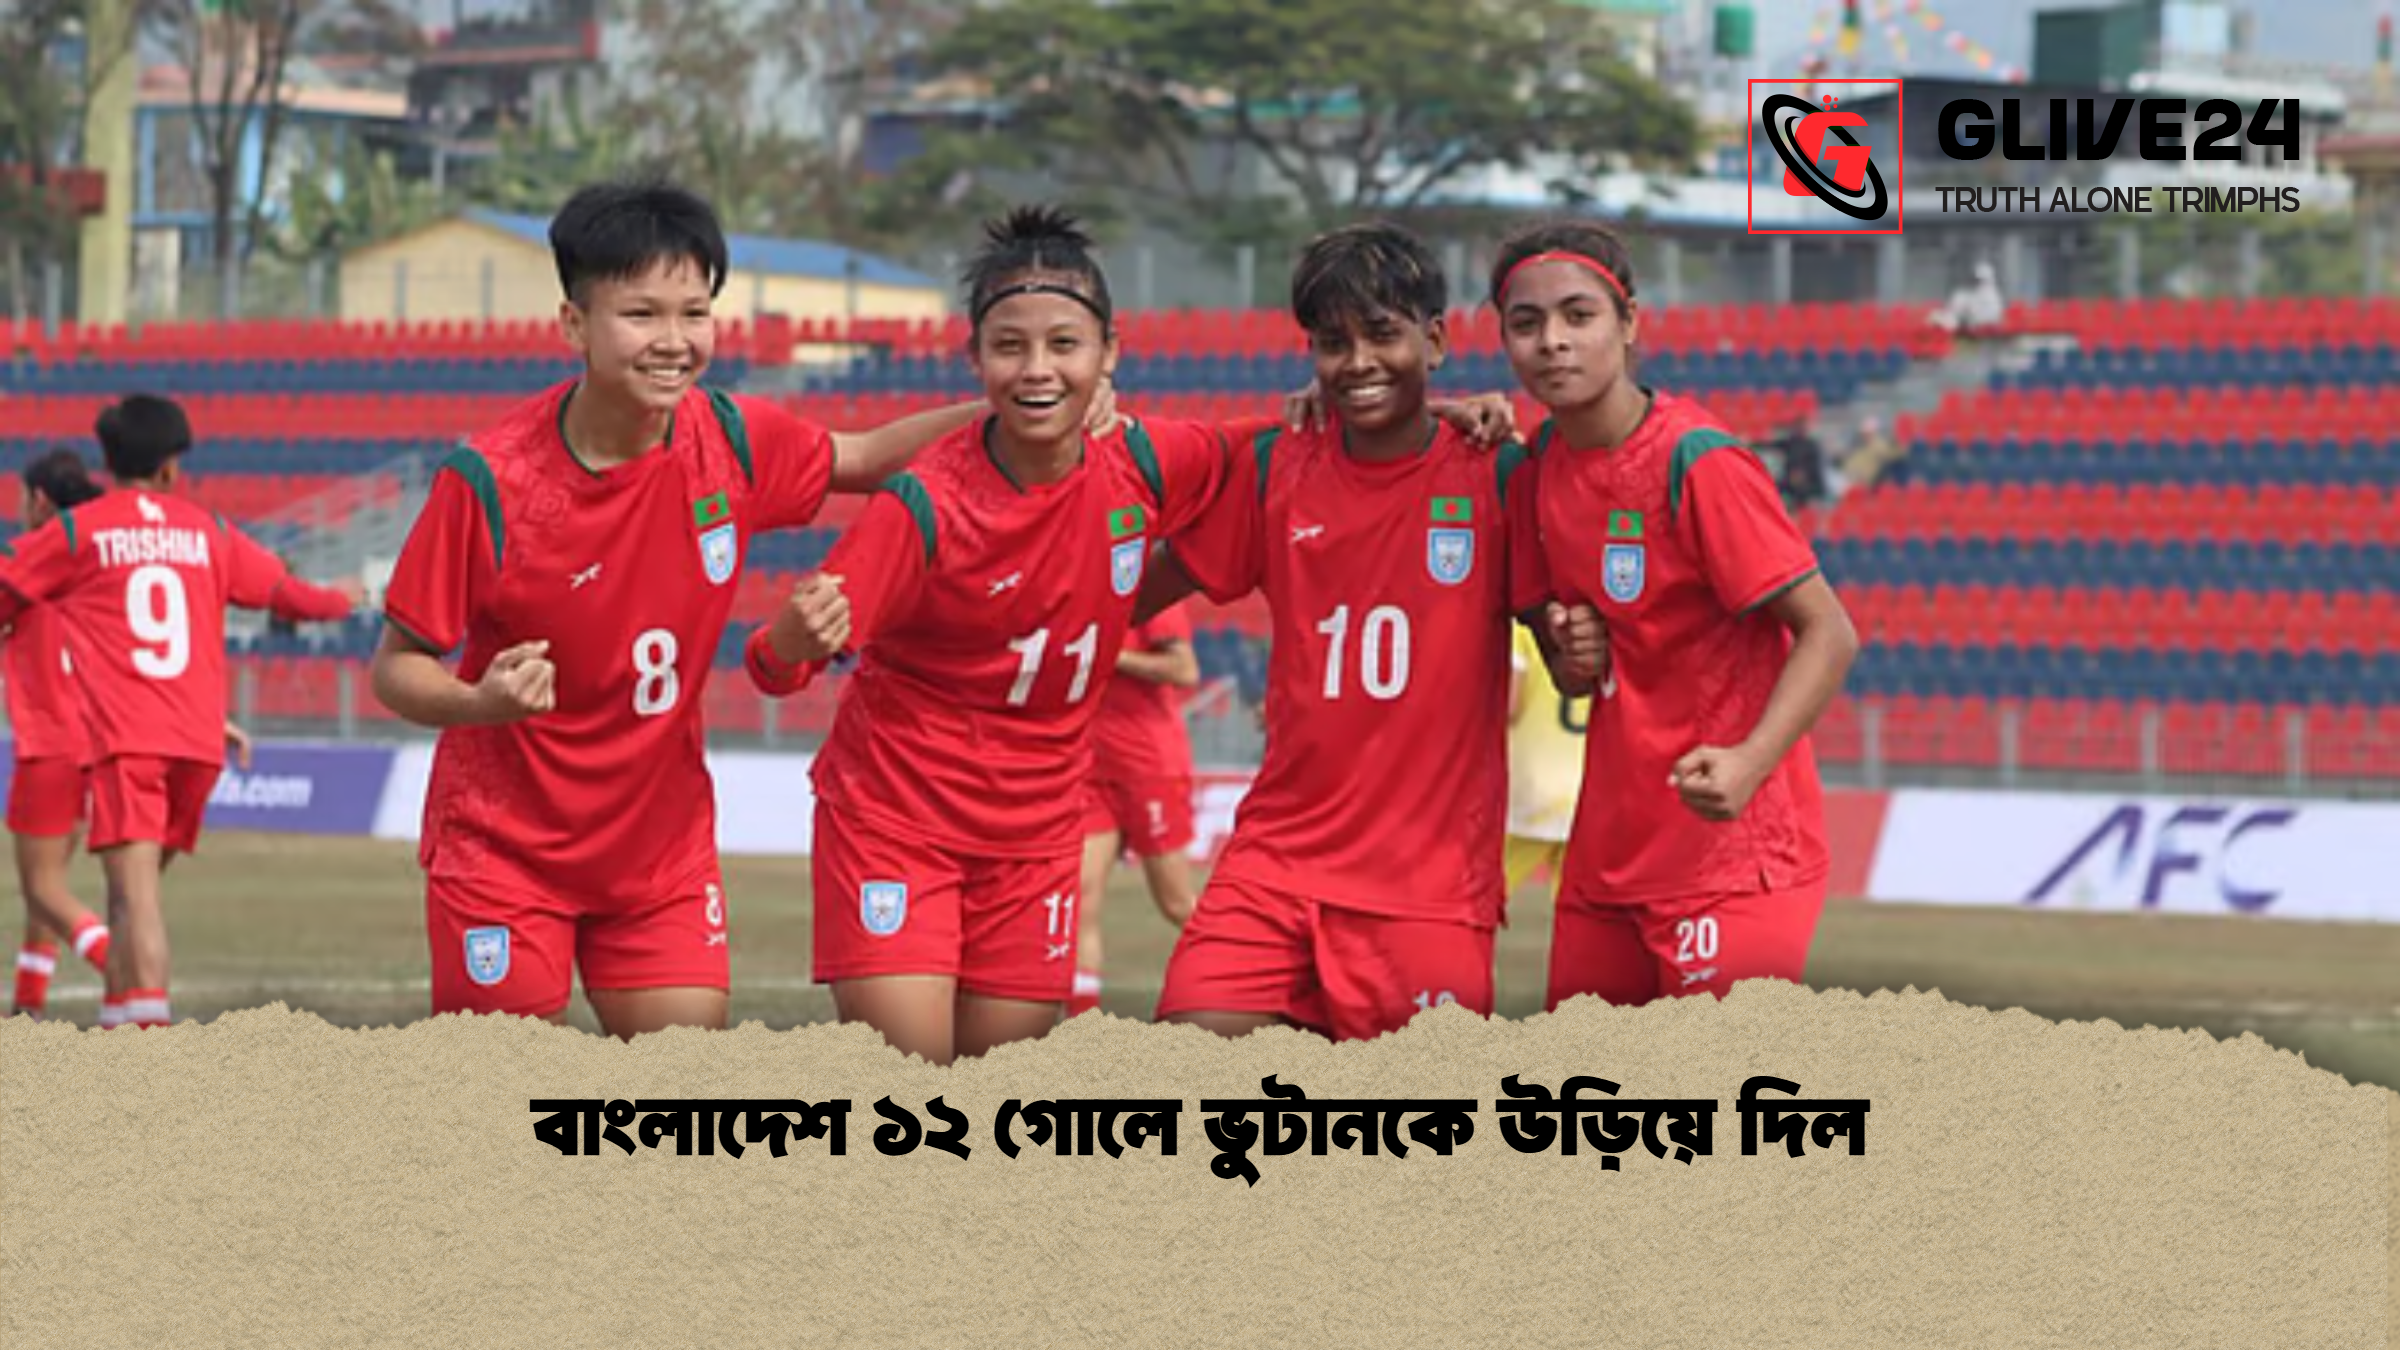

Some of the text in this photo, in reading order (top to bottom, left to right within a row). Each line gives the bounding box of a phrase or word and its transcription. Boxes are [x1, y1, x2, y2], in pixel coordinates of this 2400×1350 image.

[126, 565, 191, 679] 9
[1007, 622, 1098, 706] 11
[1317, 604, 1411, 699] 10
[632, 628, 680, 716] 8
[2023, 804, 2300, 912] AFC
[1044, 890, 1074, 937] 11
[1676, 916, 1719, 961] 20
